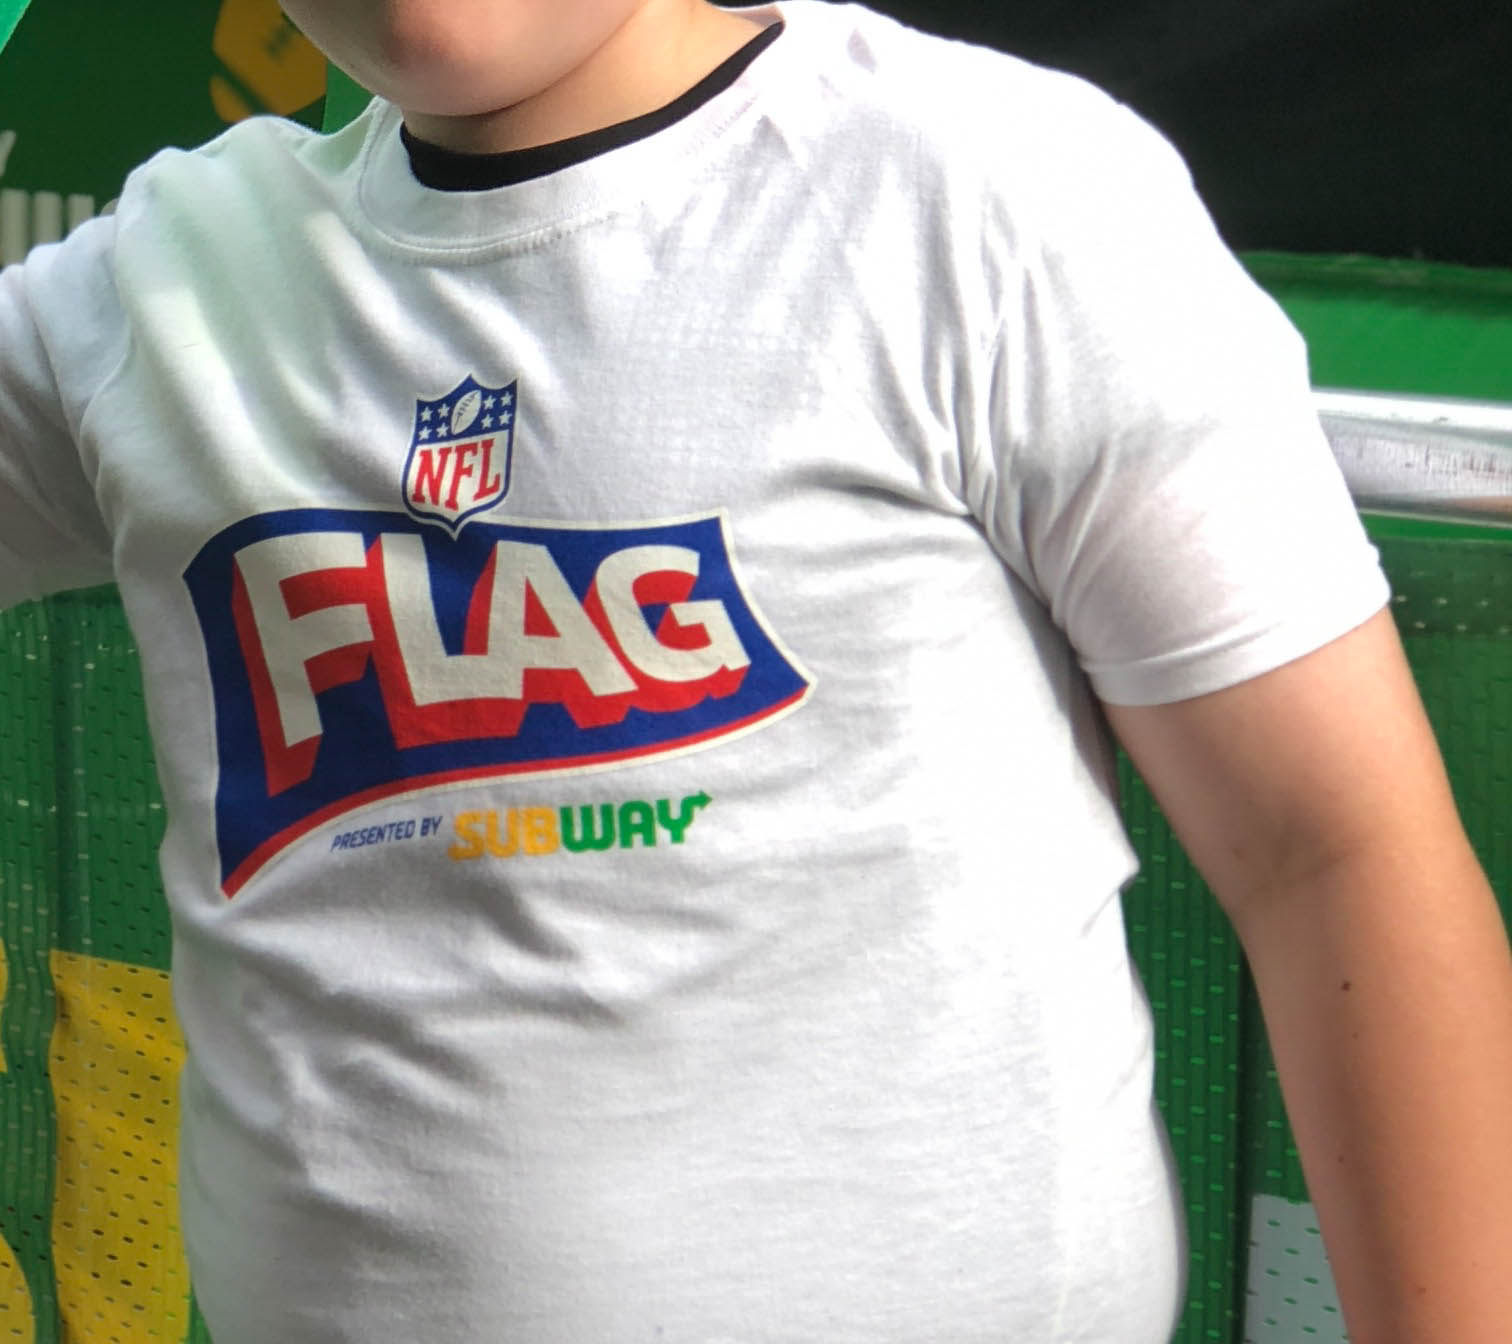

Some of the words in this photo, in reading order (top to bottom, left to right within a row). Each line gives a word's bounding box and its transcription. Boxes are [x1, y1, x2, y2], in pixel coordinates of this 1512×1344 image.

[411, 437, 501, 512] NFL
[232, 531, 752, 794] FLAG
[330, 819, 417, 854] PRESENTED
[420, 815, 443, 839] BY
[447, 790, 713, 863] SUBWAY
